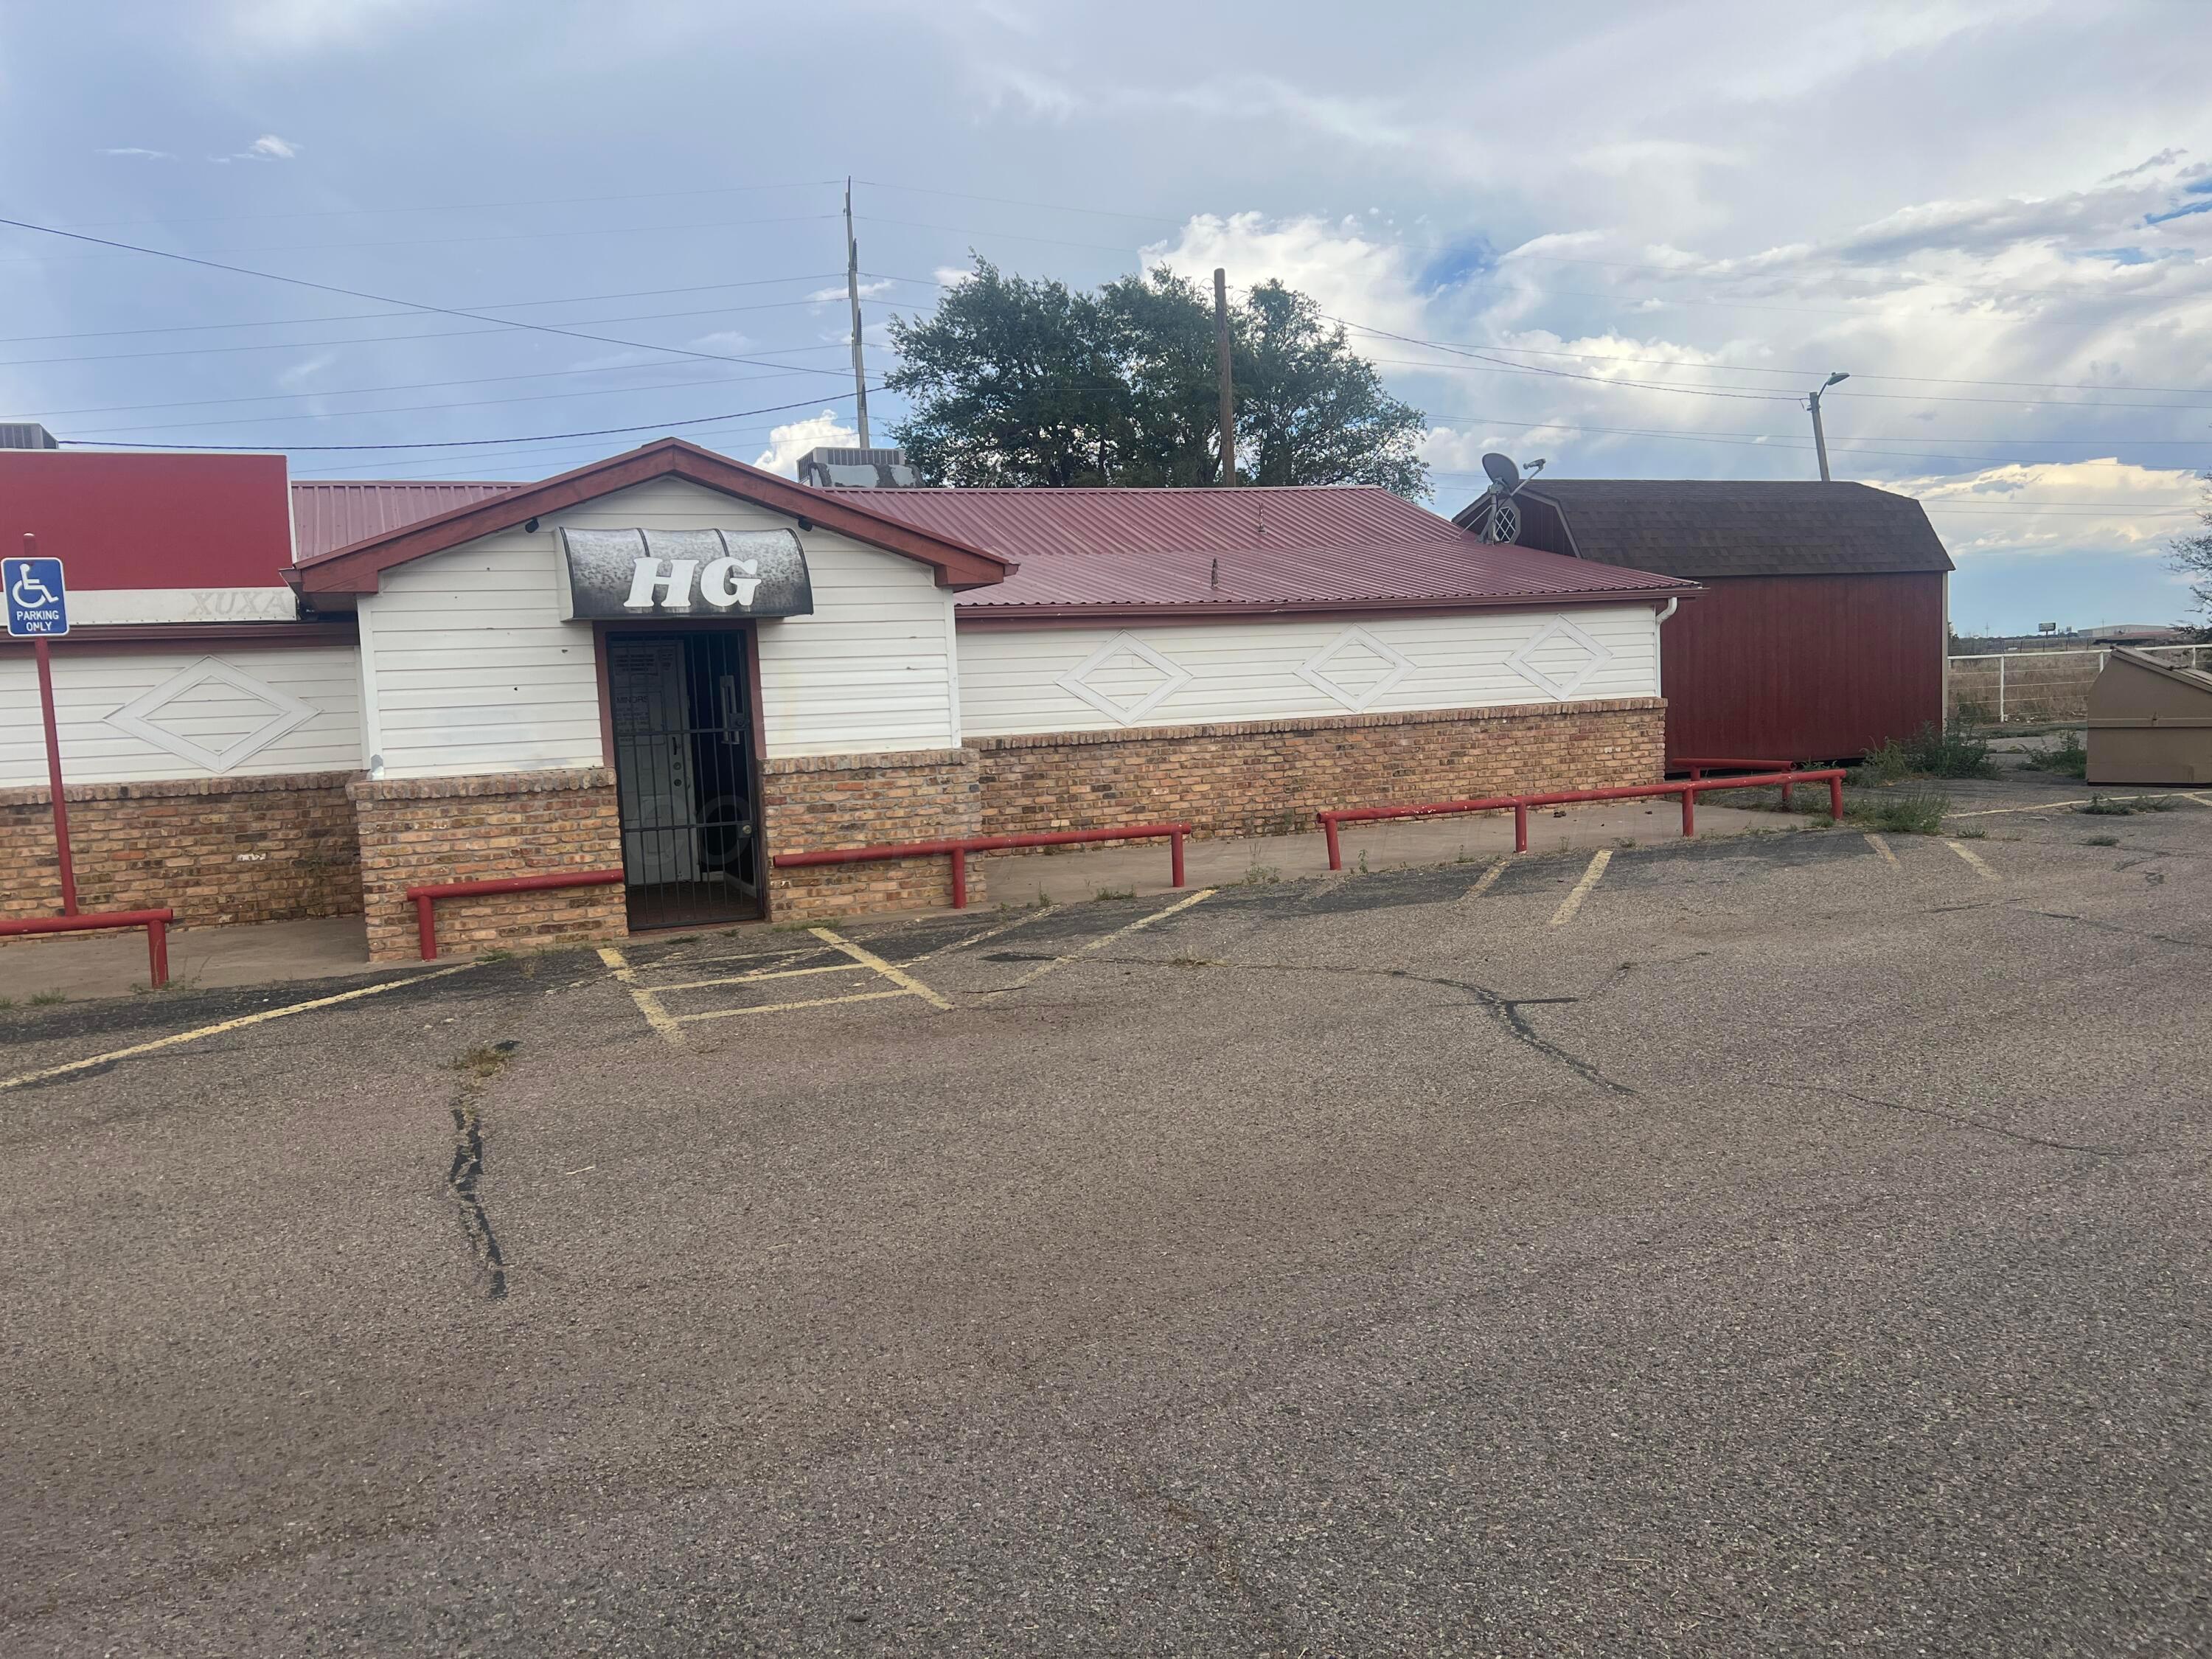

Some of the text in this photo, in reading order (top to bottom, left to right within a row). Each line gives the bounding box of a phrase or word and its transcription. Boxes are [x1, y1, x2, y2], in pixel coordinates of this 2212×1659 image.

[623, 557, 762, 607] HG
[188, 591, 290, 615] XUXA
[16, 611, 59, 620] PARKING
[26, 622, 52, 631] ONLY
